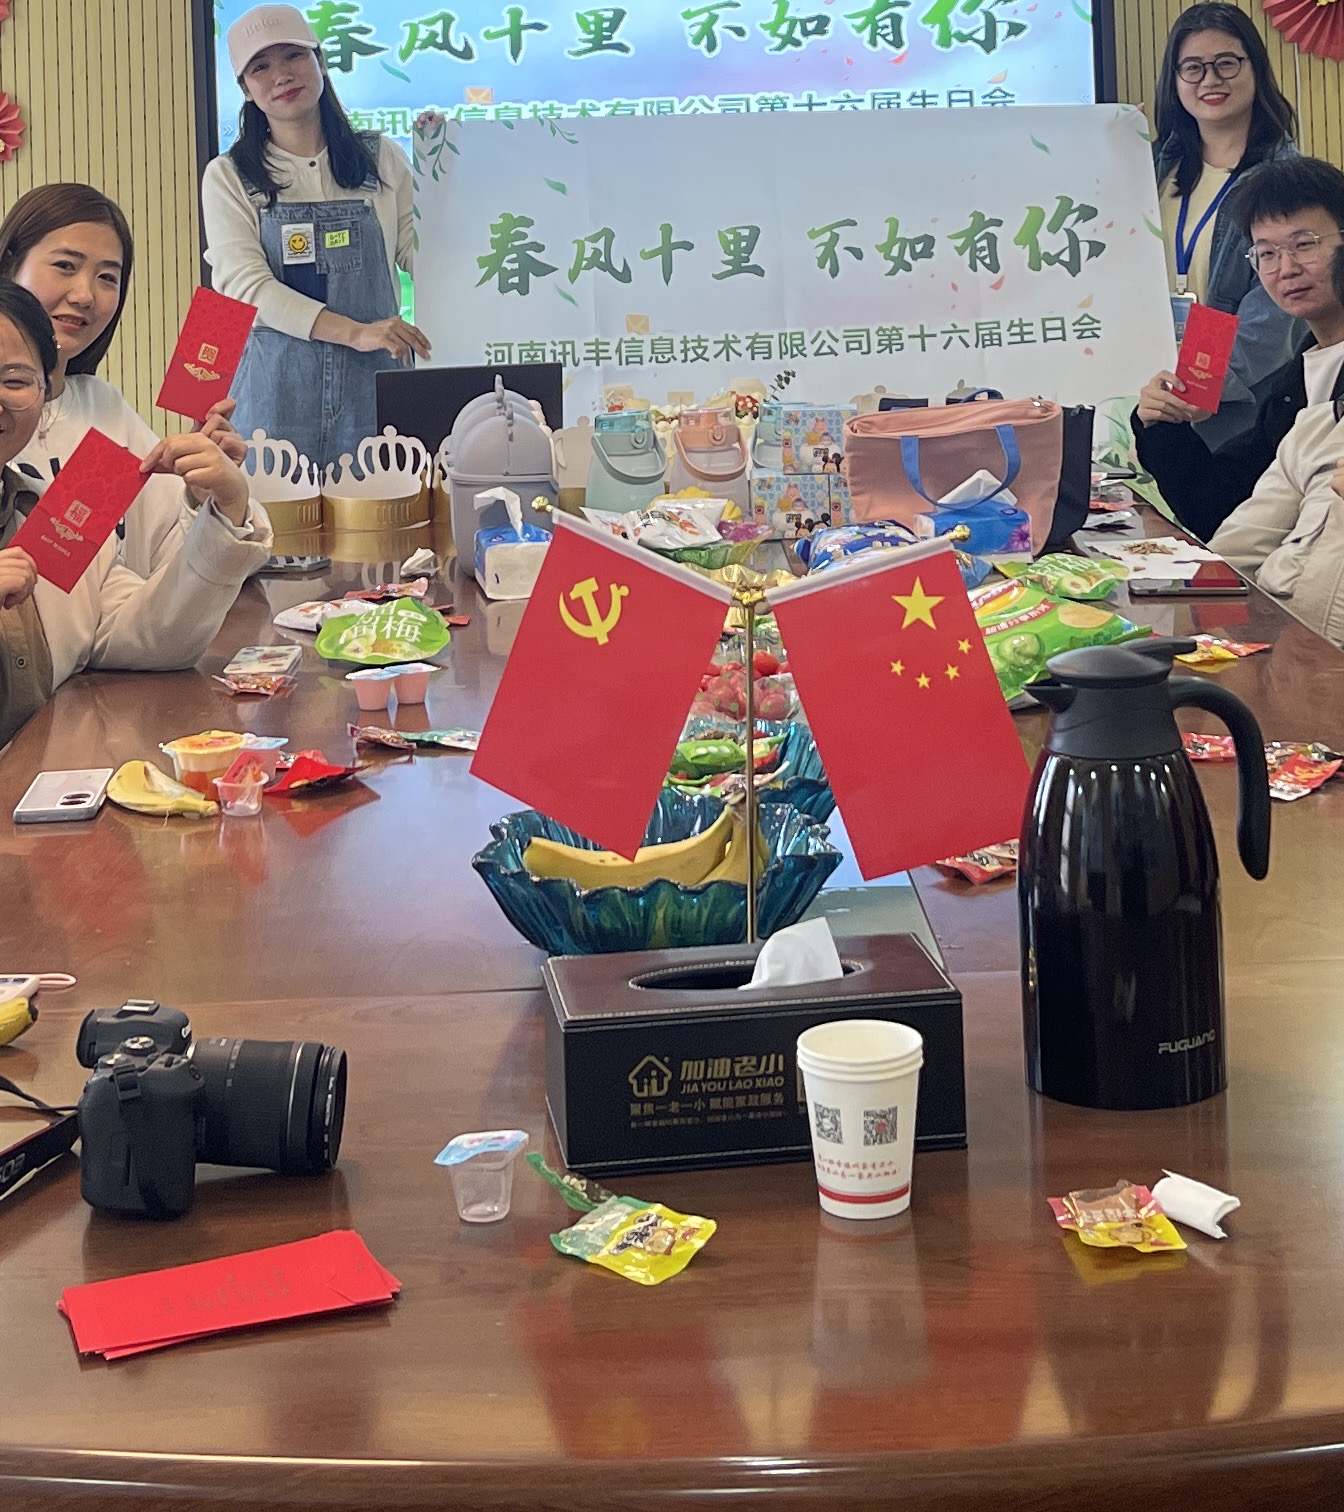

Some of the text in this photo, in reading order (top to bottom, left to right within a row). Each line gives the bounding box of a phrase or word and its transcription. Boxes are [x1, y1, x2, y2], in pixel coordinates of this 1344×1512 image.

[305, 0, 631, 72] 春风十里
[476, 196, 1105, 296] 春风十里 不如有你
[485, 312, 1102, 368] 河南讯丰信息技术有限公司第十六届生日会
[680, 1054, 784, 1080] 加油老小
[680, 1076, 785, 1095] JIA YOU LAO XIAO
